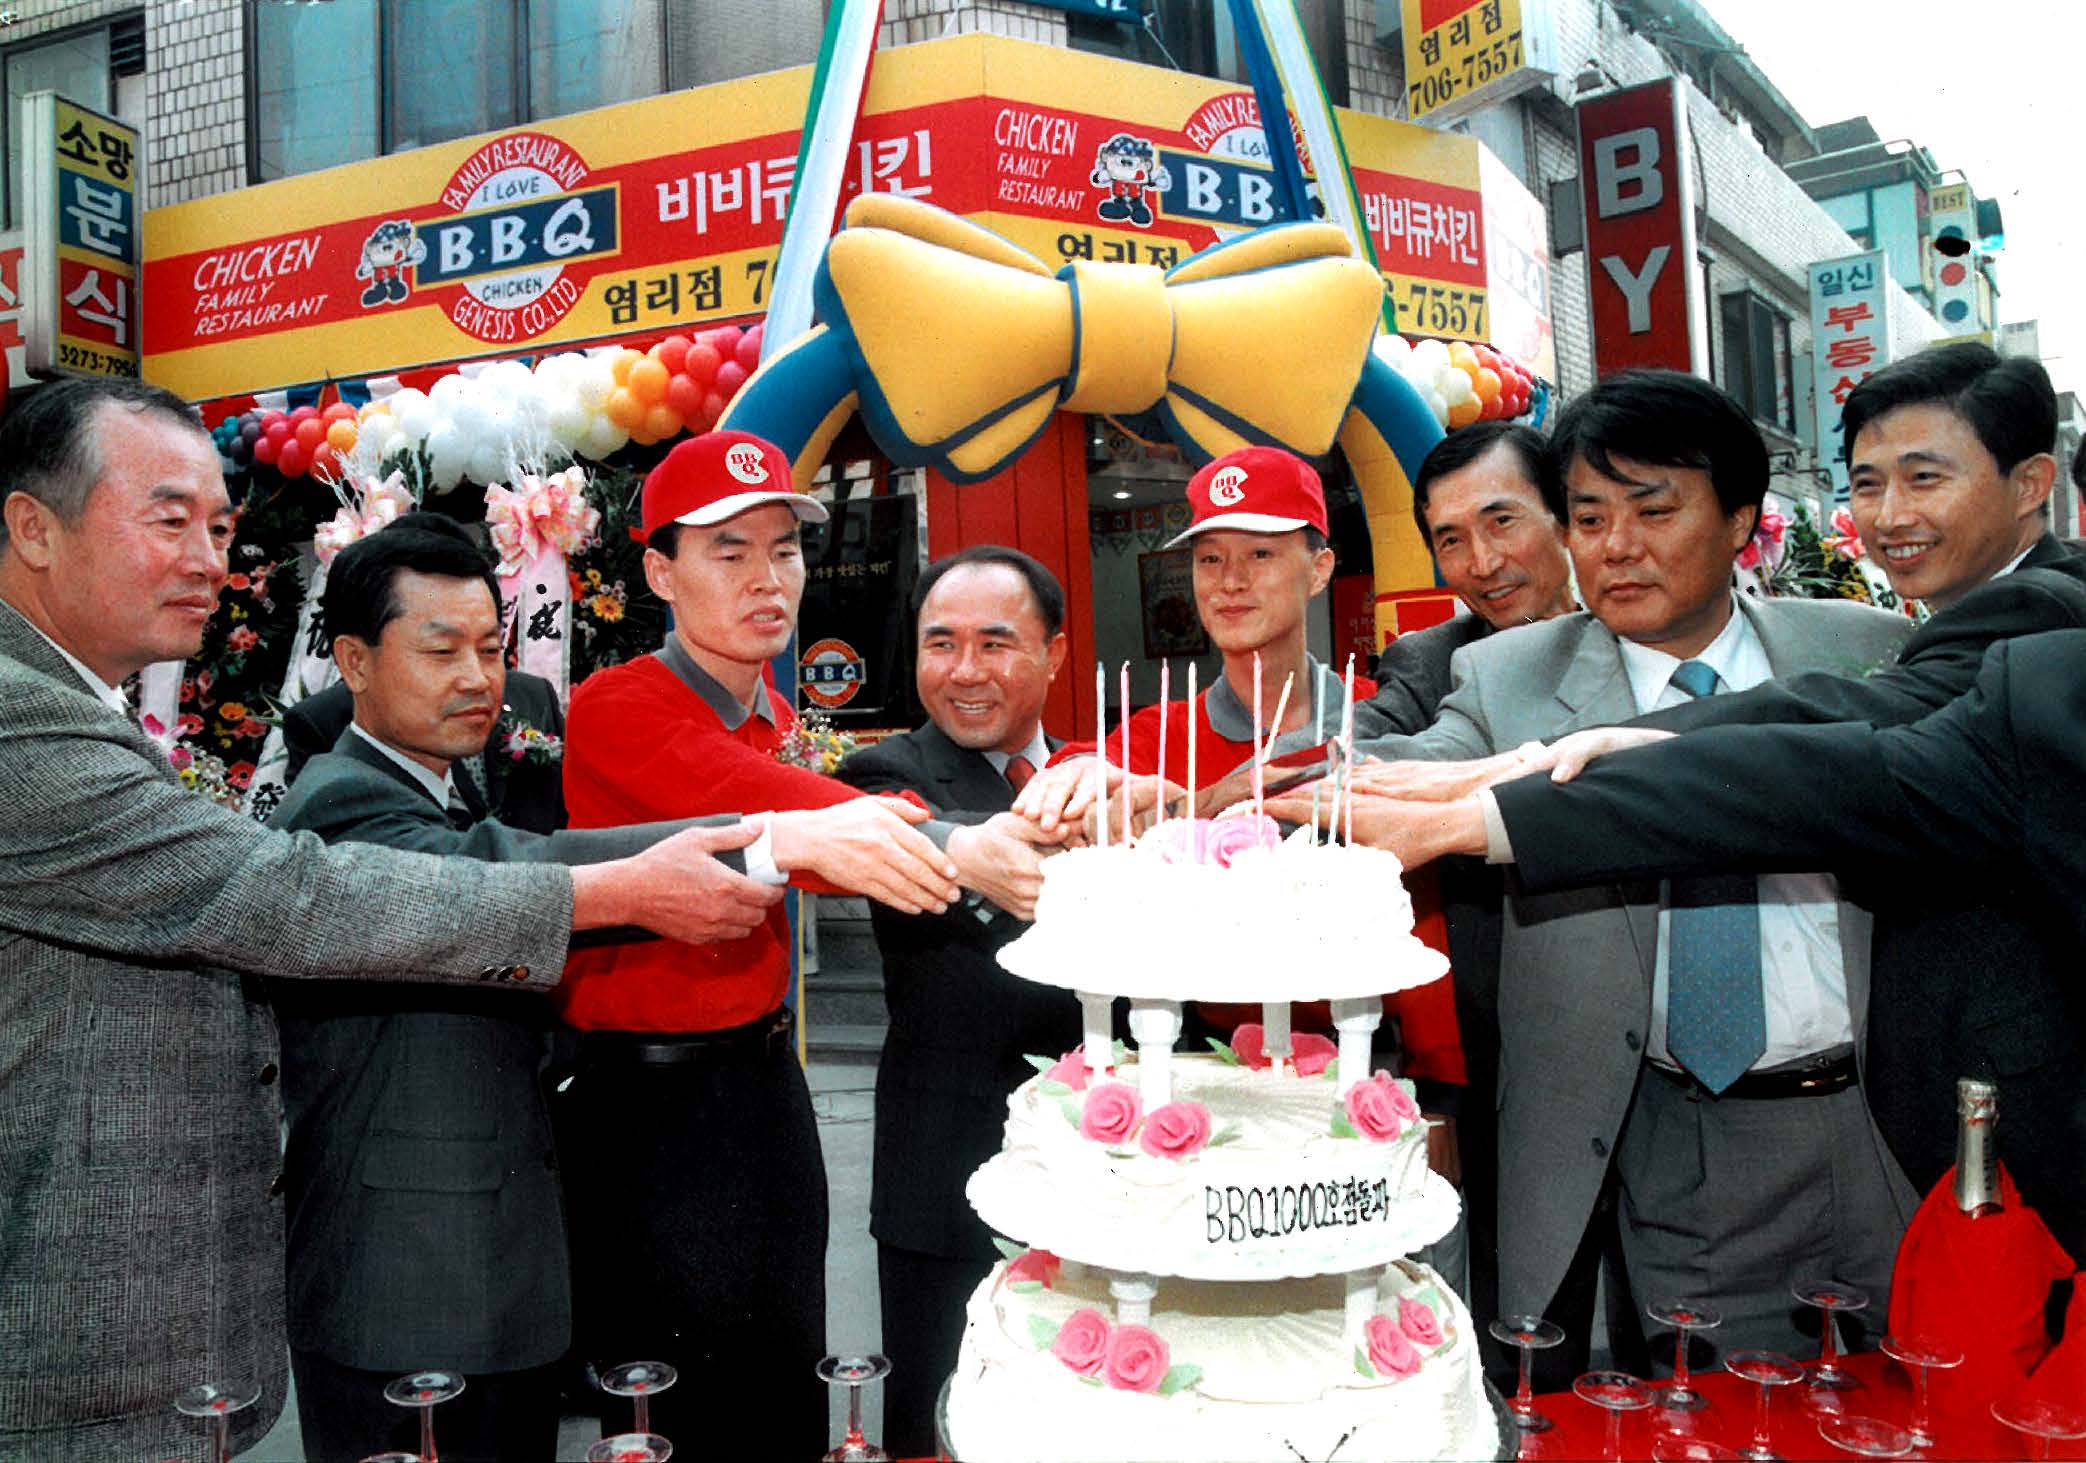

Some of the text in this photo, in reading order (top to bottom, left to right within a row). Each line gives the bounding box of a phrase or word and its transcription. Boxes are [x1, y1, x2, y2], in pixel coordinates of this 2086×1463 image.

[1419, 0, 1501, 66] 염리점
[1409, 28, 1522, 114] 706-7557
[994, 108, 1078, 157] CHICKEN
[1186, 98, 1236, 151] FAMILY
[57, 120, 134, 181] 소망
[996, 152, 1052, 180] FAMILY
[1242, 138, 1271, 159] LO
[442, 136, 587, 211] FAMILY RESTAURANT
[481, 176, 541, 202] I LOVE
[998, 179, 1086, 212] RESTAURANT
[1364, 192, 1479, 265] 비비큐치킨
[194, 235, 322, 291] CHICKEN
[1818, 263, 1874, 296] 일신
[194, 281, 276, 315] FAMILY
[482, 277, 543, 301] CHICKEN
[604, 264, 722, 324] 염리점
[194, 294, 328, 336] RESTAURANT
[453, 296, 515, 340] GENESIS
